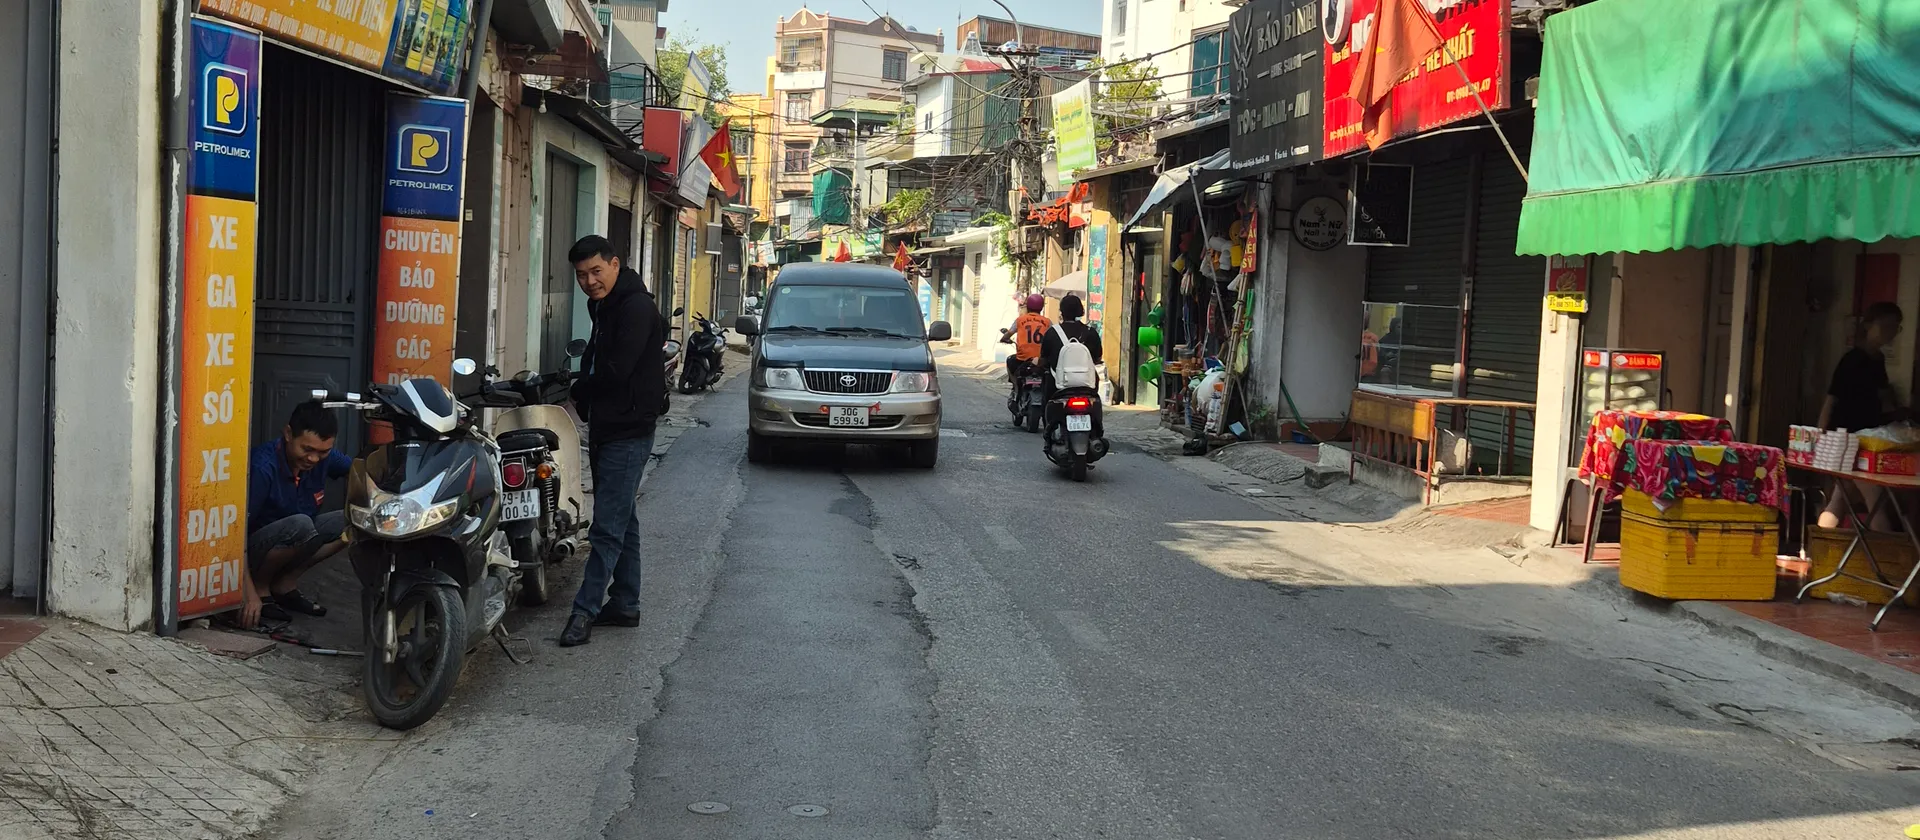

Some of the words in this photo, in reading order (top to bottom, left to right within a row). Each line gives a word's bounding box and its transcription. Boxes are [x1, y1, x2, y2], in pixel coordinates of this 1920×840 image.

[1284, 0, 1317, 41] BÌNH
[194, 141, 251, 159] PETROLIMEX
[389, 178, 454, 192] PETROLIMEX
[208, 215, 238, 250] XE
[1300, 218, 1320, 228] Nam
[385, 228, 454, 255] CHUYÊN
[400, 260, 435, 289] BẢO
[207, 274, 237, 308] GA
[385, 298, 445, 325] DƯỠNG
[396, 335, 431, 360] CÁC
[1025, 325, 1044, 344] 16
[204, 333, 234, 367] XE
[203, 378, 236, 425] SỐ
[841, 408, 858, 416] 30G
[834, 416, 864, 425] 599.94
[200, 447, 231, 484] XE
[502, 491, 532, 506] 29-AA
[187, 504, 238, 547] ĐẠP
[179, 556, 240, 604] ĐIỆN
